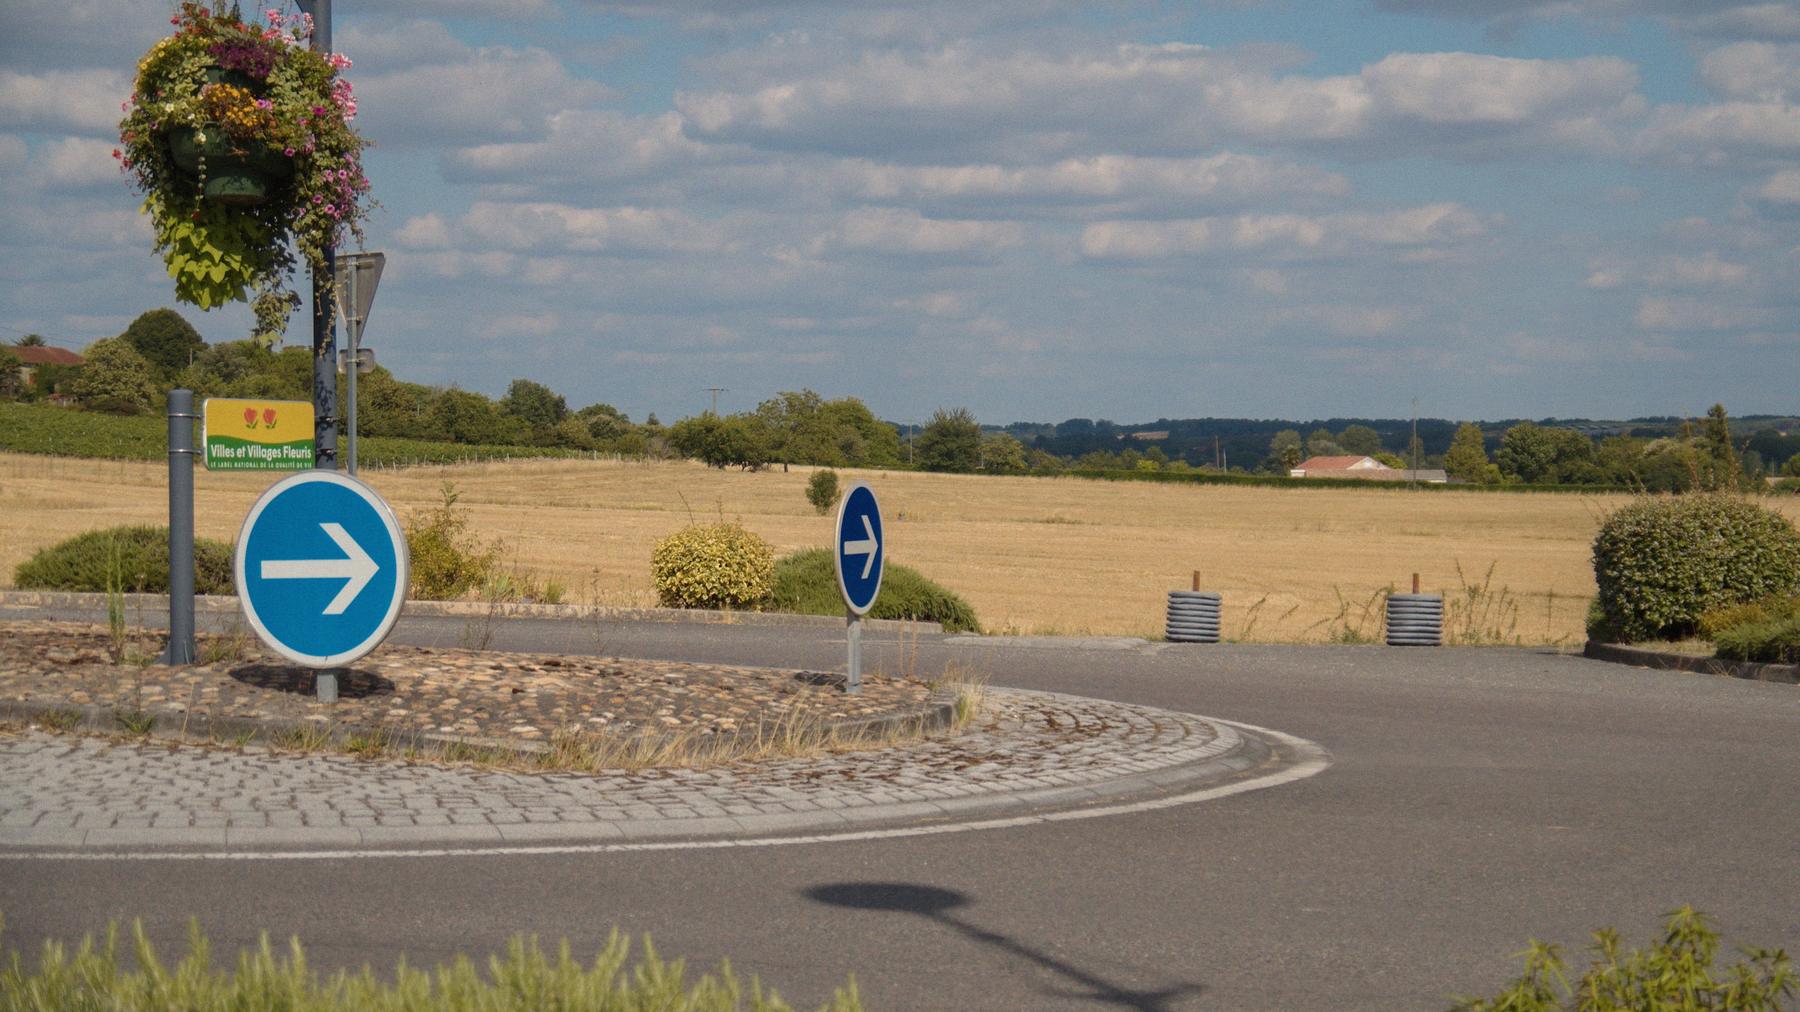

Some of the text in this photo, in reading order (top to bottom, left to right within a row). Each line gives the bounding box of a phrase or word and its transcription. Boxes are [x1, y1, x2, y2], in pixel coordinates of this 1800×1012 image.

[210, 444, 312, 461] Villes et Villages Fleuris
[234, 461, 259, 469] NATIONAL
